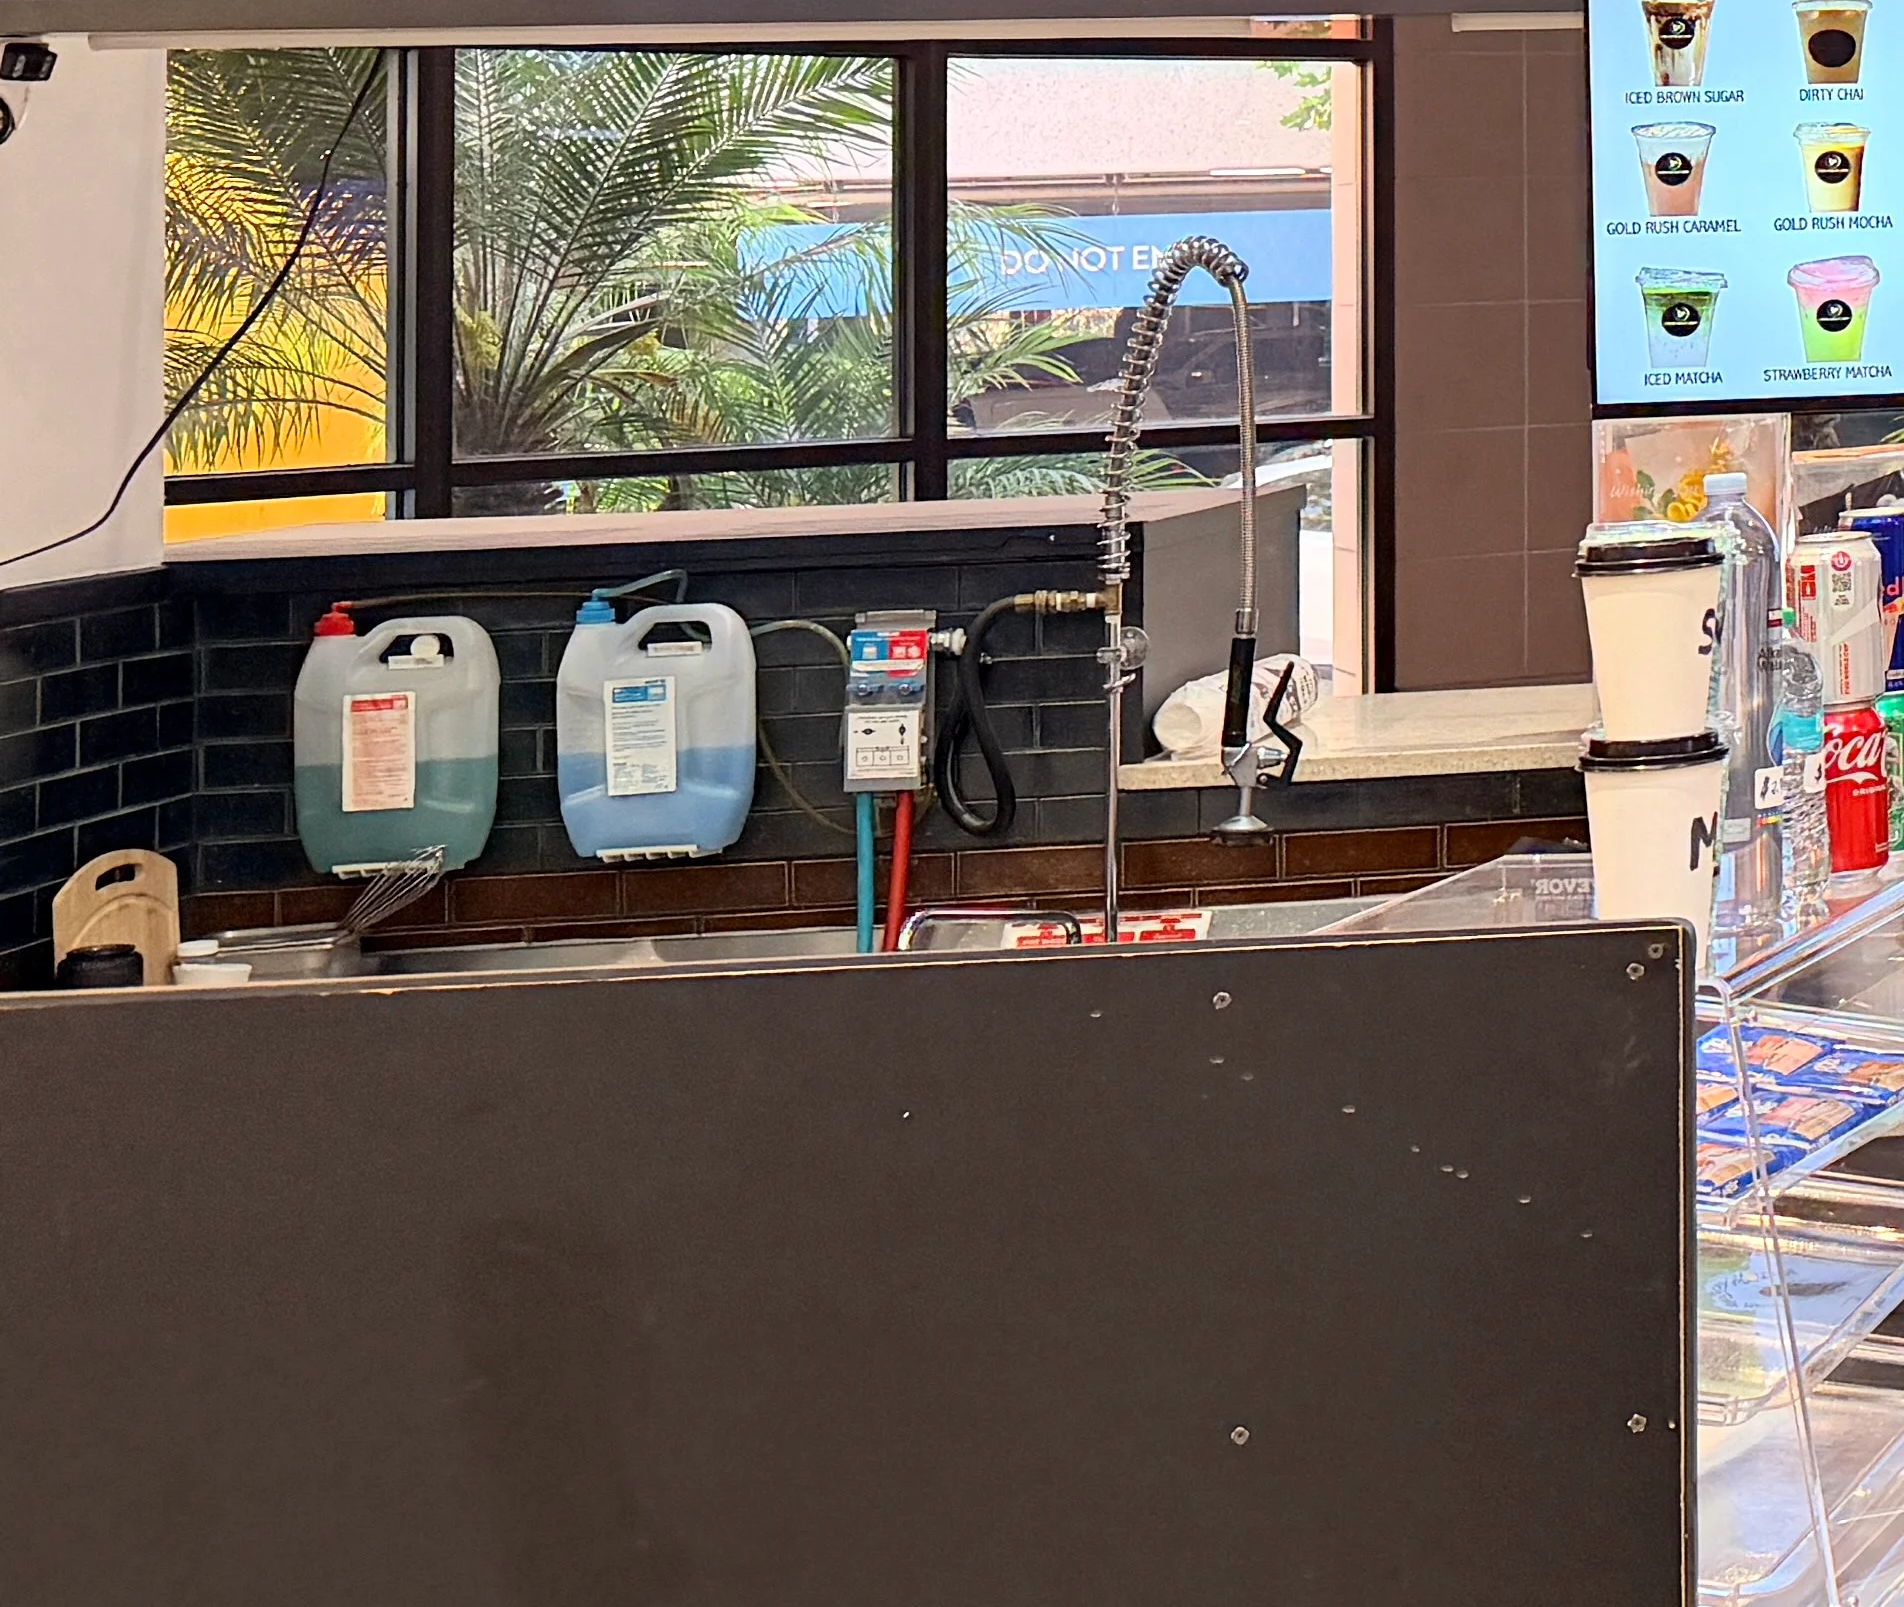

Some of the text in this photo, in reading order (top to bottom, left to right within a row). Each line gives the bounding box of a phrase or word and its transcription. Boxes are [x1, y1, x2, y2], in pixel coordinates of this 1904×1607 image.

[1625, 89, 1744, 104] ICED BROWN SUGAR
[1799, 88, 1863, 101] DIRTY CHAI
[1607, 219, 1742, 235] GOLD RUSH CARAMEL
[1774, 215, 1893, 231] GOLD RUSH MOCHA
[1001, 248, 1049, 275] DO
[1644, 371, 1723, 386] ICED MATCHA
[1763, 365, 1892, 382] STRAWBERRY MATCHA
